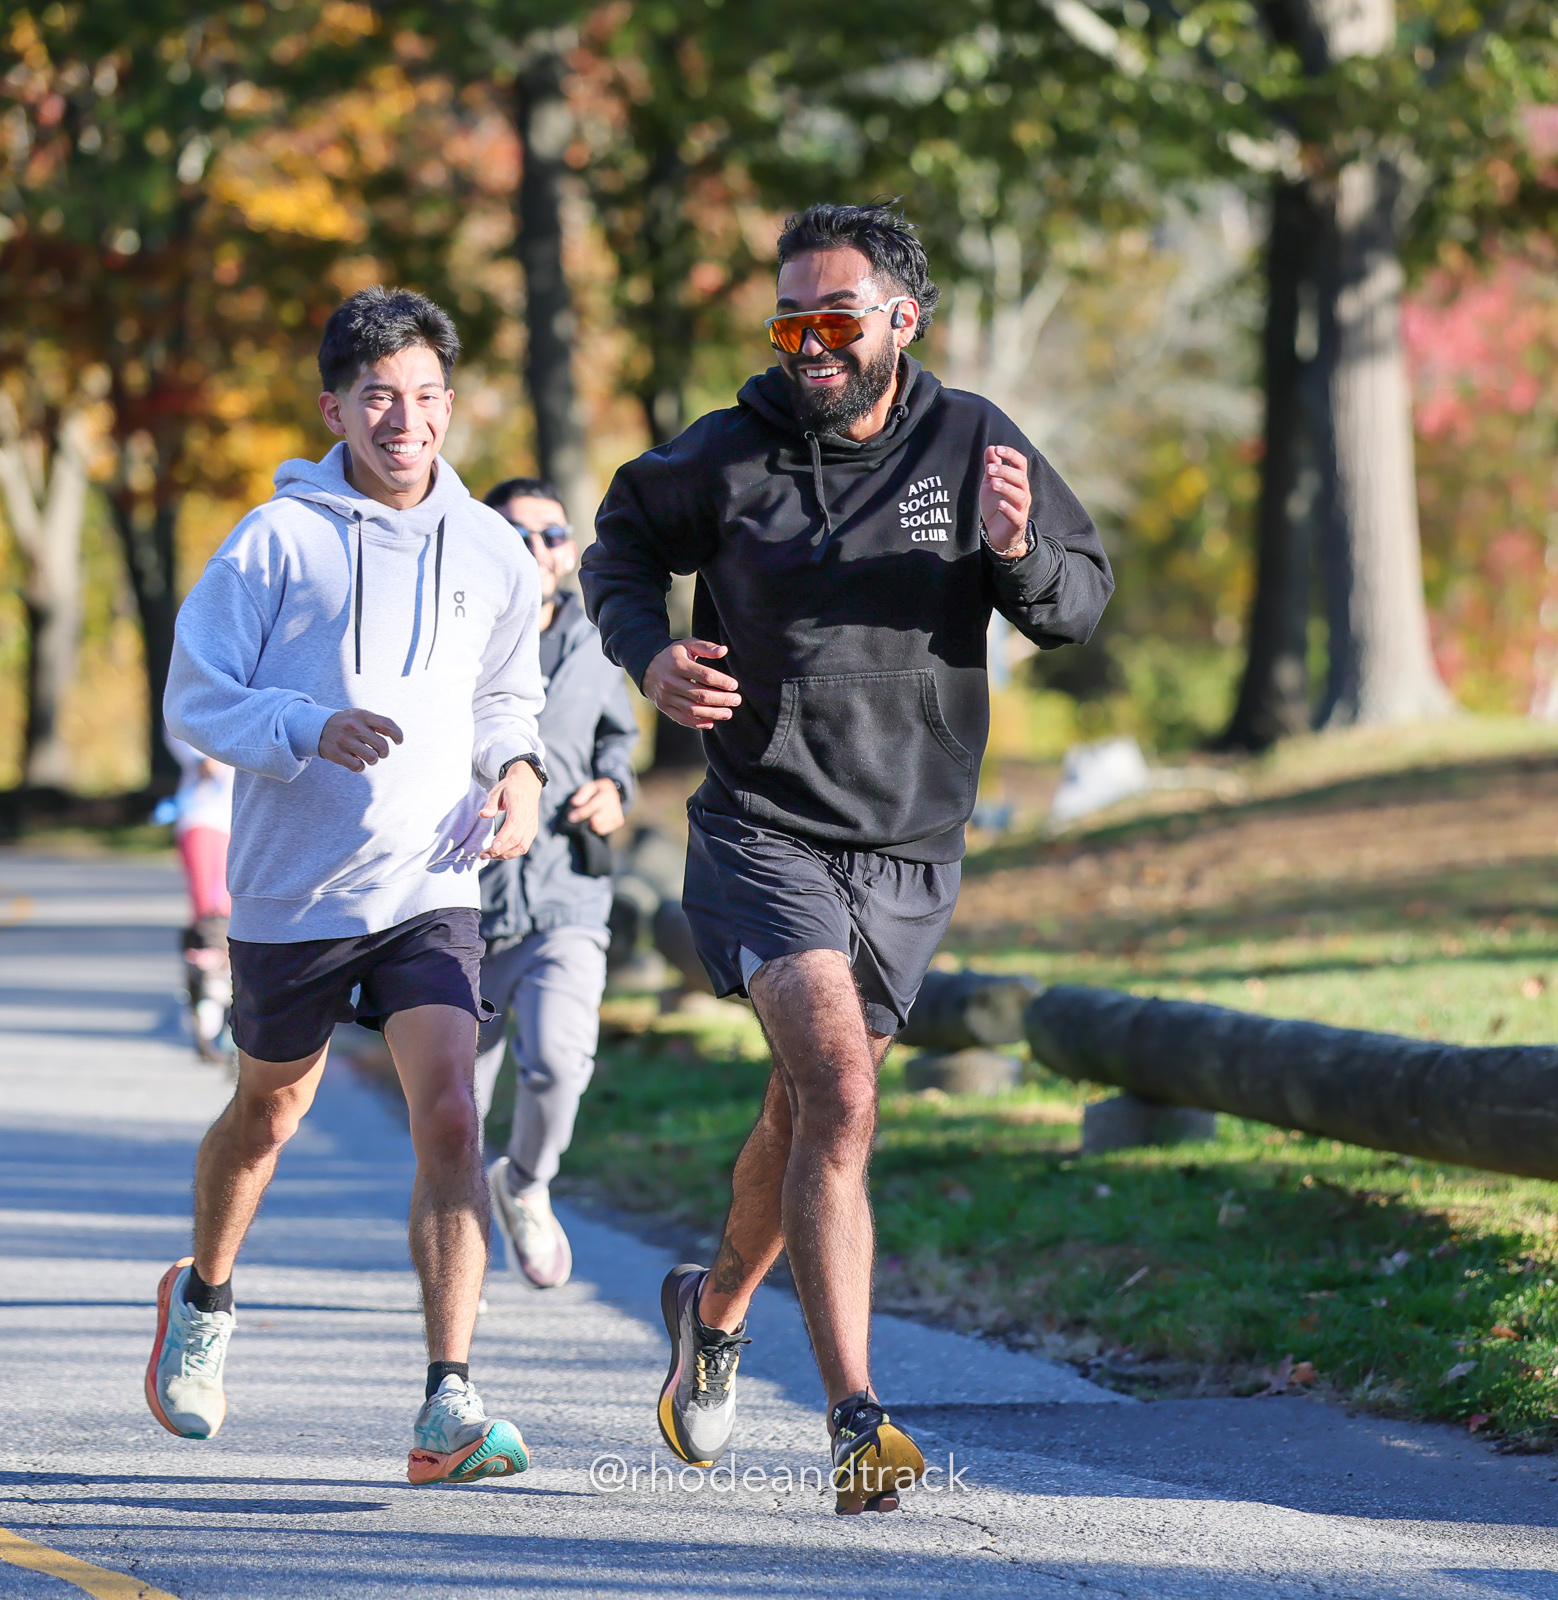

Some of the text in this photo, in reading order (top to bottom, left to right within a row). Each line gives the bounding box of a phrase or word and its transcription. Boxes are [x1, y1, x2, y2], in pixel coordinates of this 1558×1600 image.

[908, 476, 942, 497] ANTI
[898, 490, 950, 514] SOCIAL
[900, 507, 952, 528] SOCIAL
